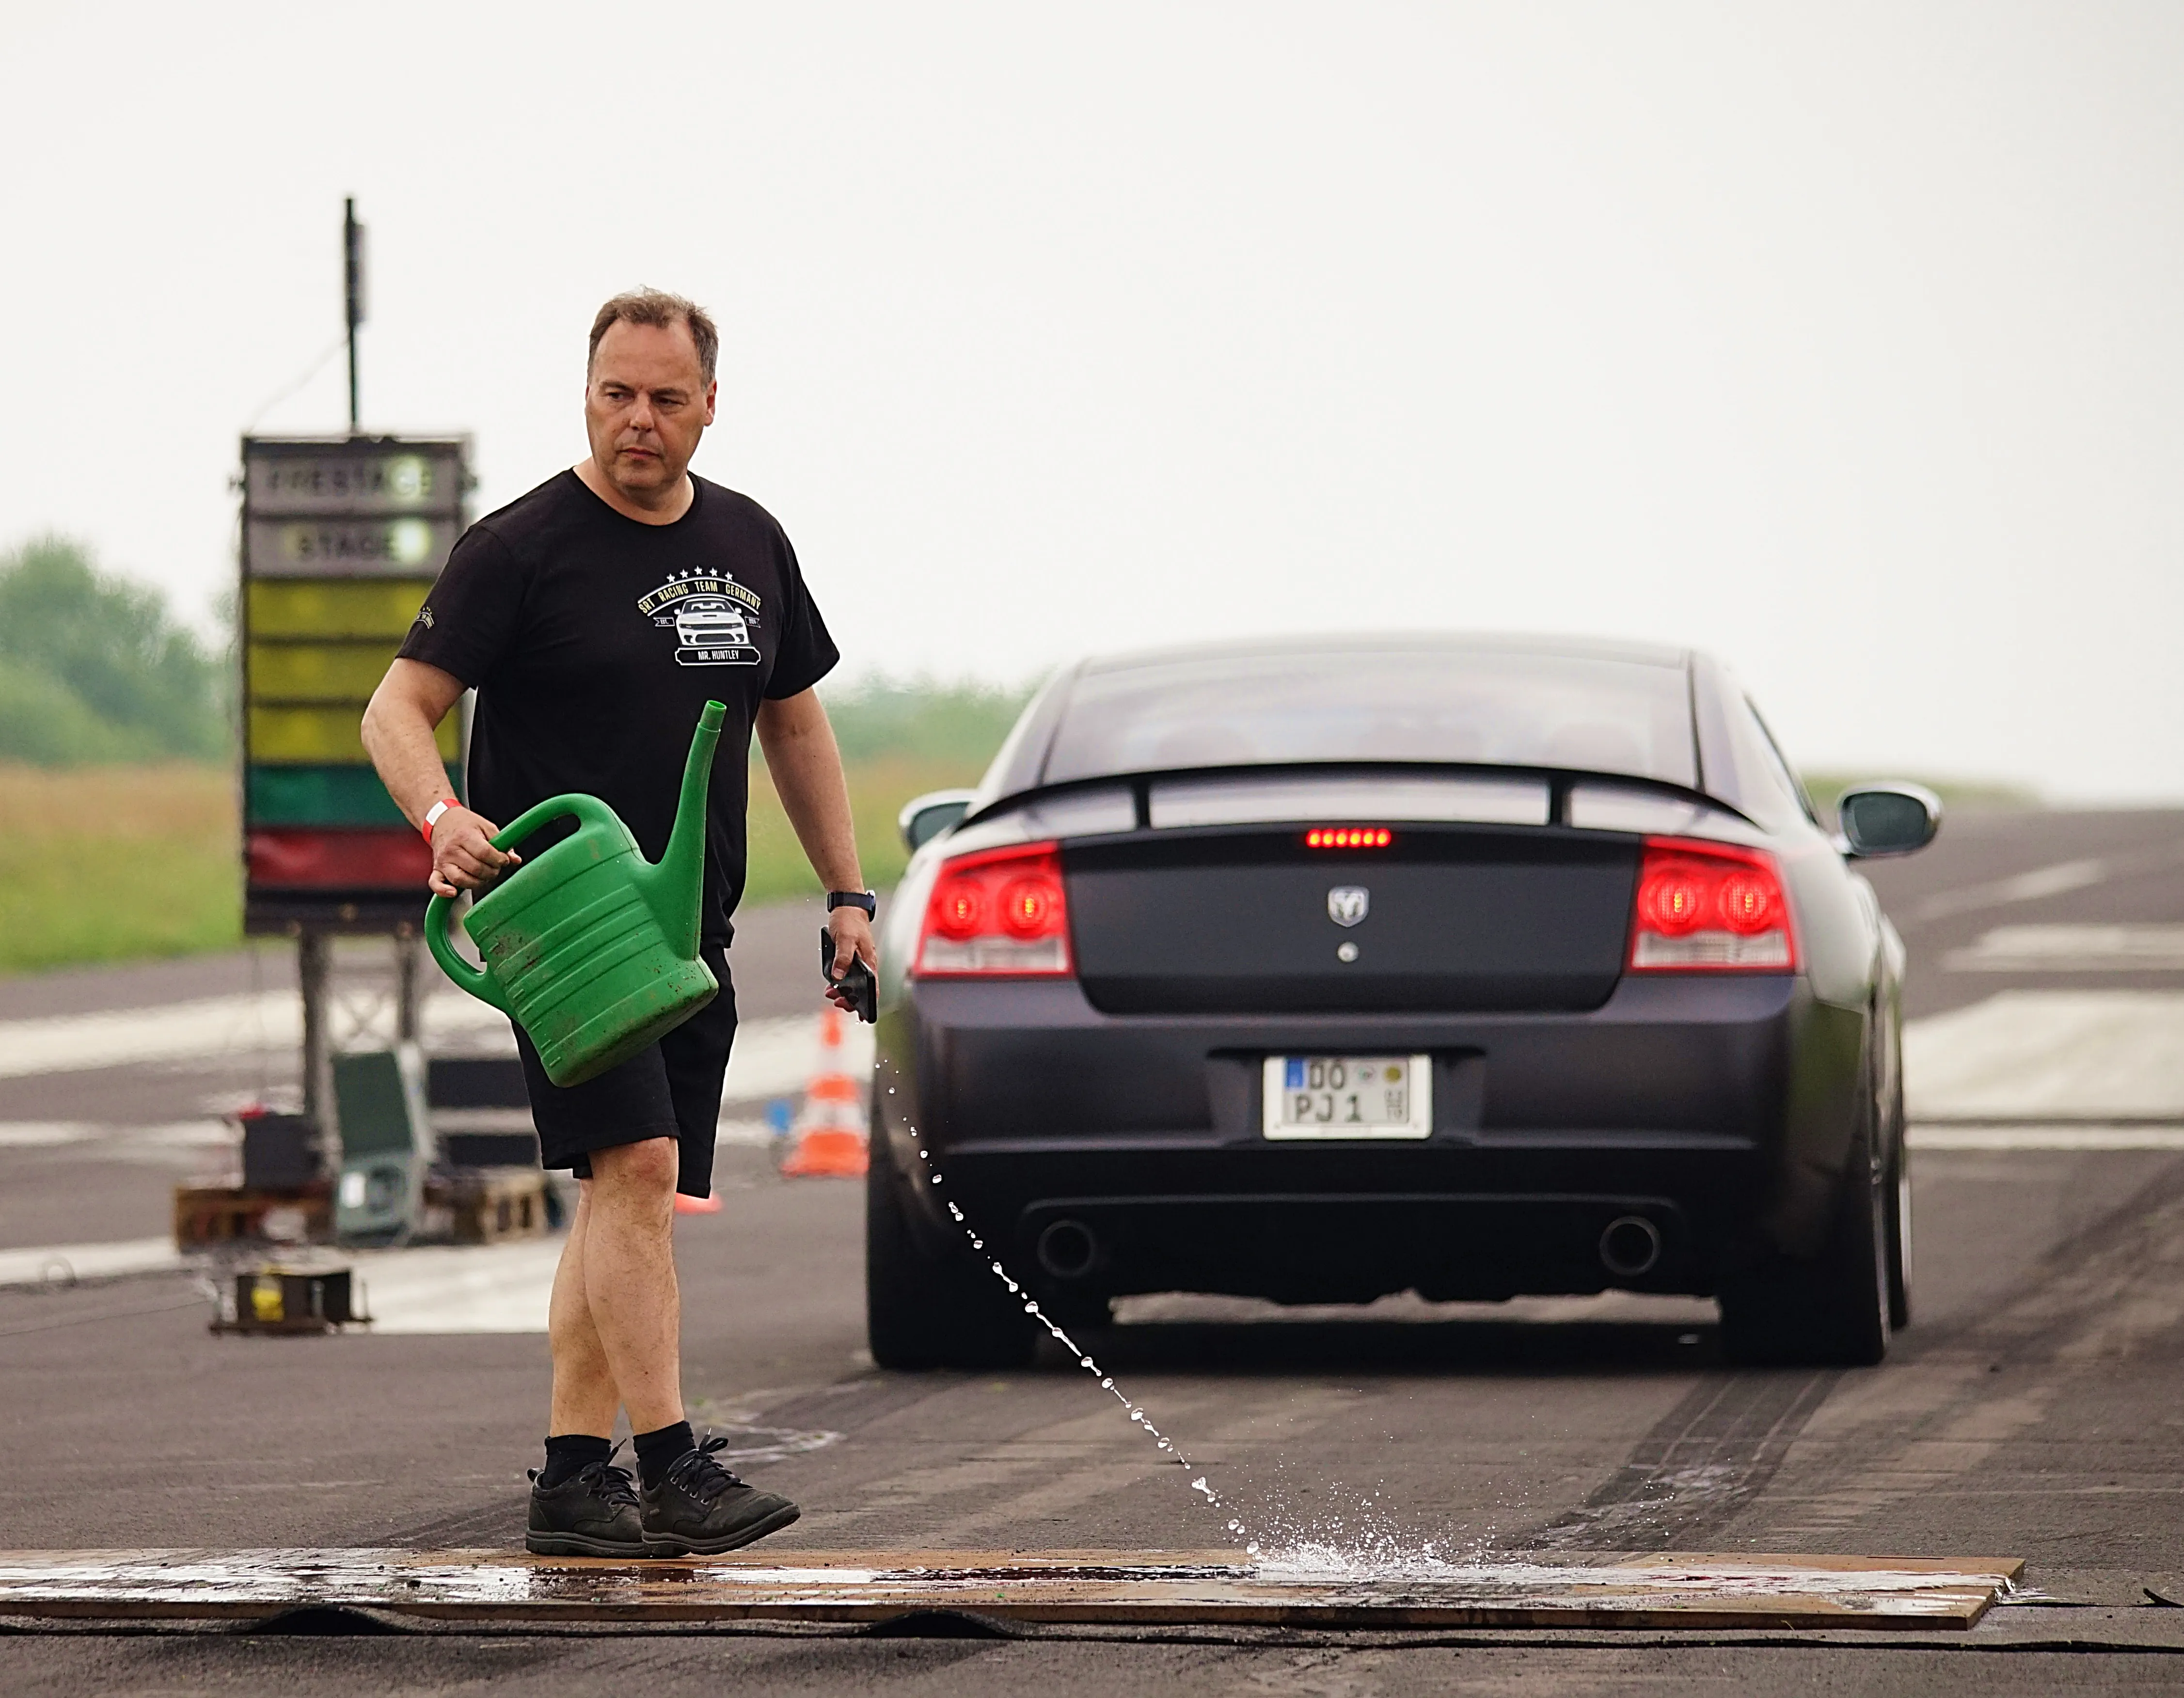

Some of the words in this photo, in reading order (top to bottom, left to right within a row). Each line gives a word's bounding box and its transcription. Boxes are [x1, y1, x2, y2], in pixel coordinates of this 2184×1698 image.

[266, 466, 434, 496] PRESTAE
[638, 597, 655, 613] SRT
[657, 583, 689, 602] RACING
[694, 581, 718, 593] TEAM
[725, 583, 761, 610] GERMANY
[697, 651, 711, 660] MR.
[712, 650, 739, 660] HUNTLEY
[1310, 1063, 1345, 1090] DO
[1295, 1094, 1333, 1123] PJ
[1344, 1094, 1363, 1123] 1
